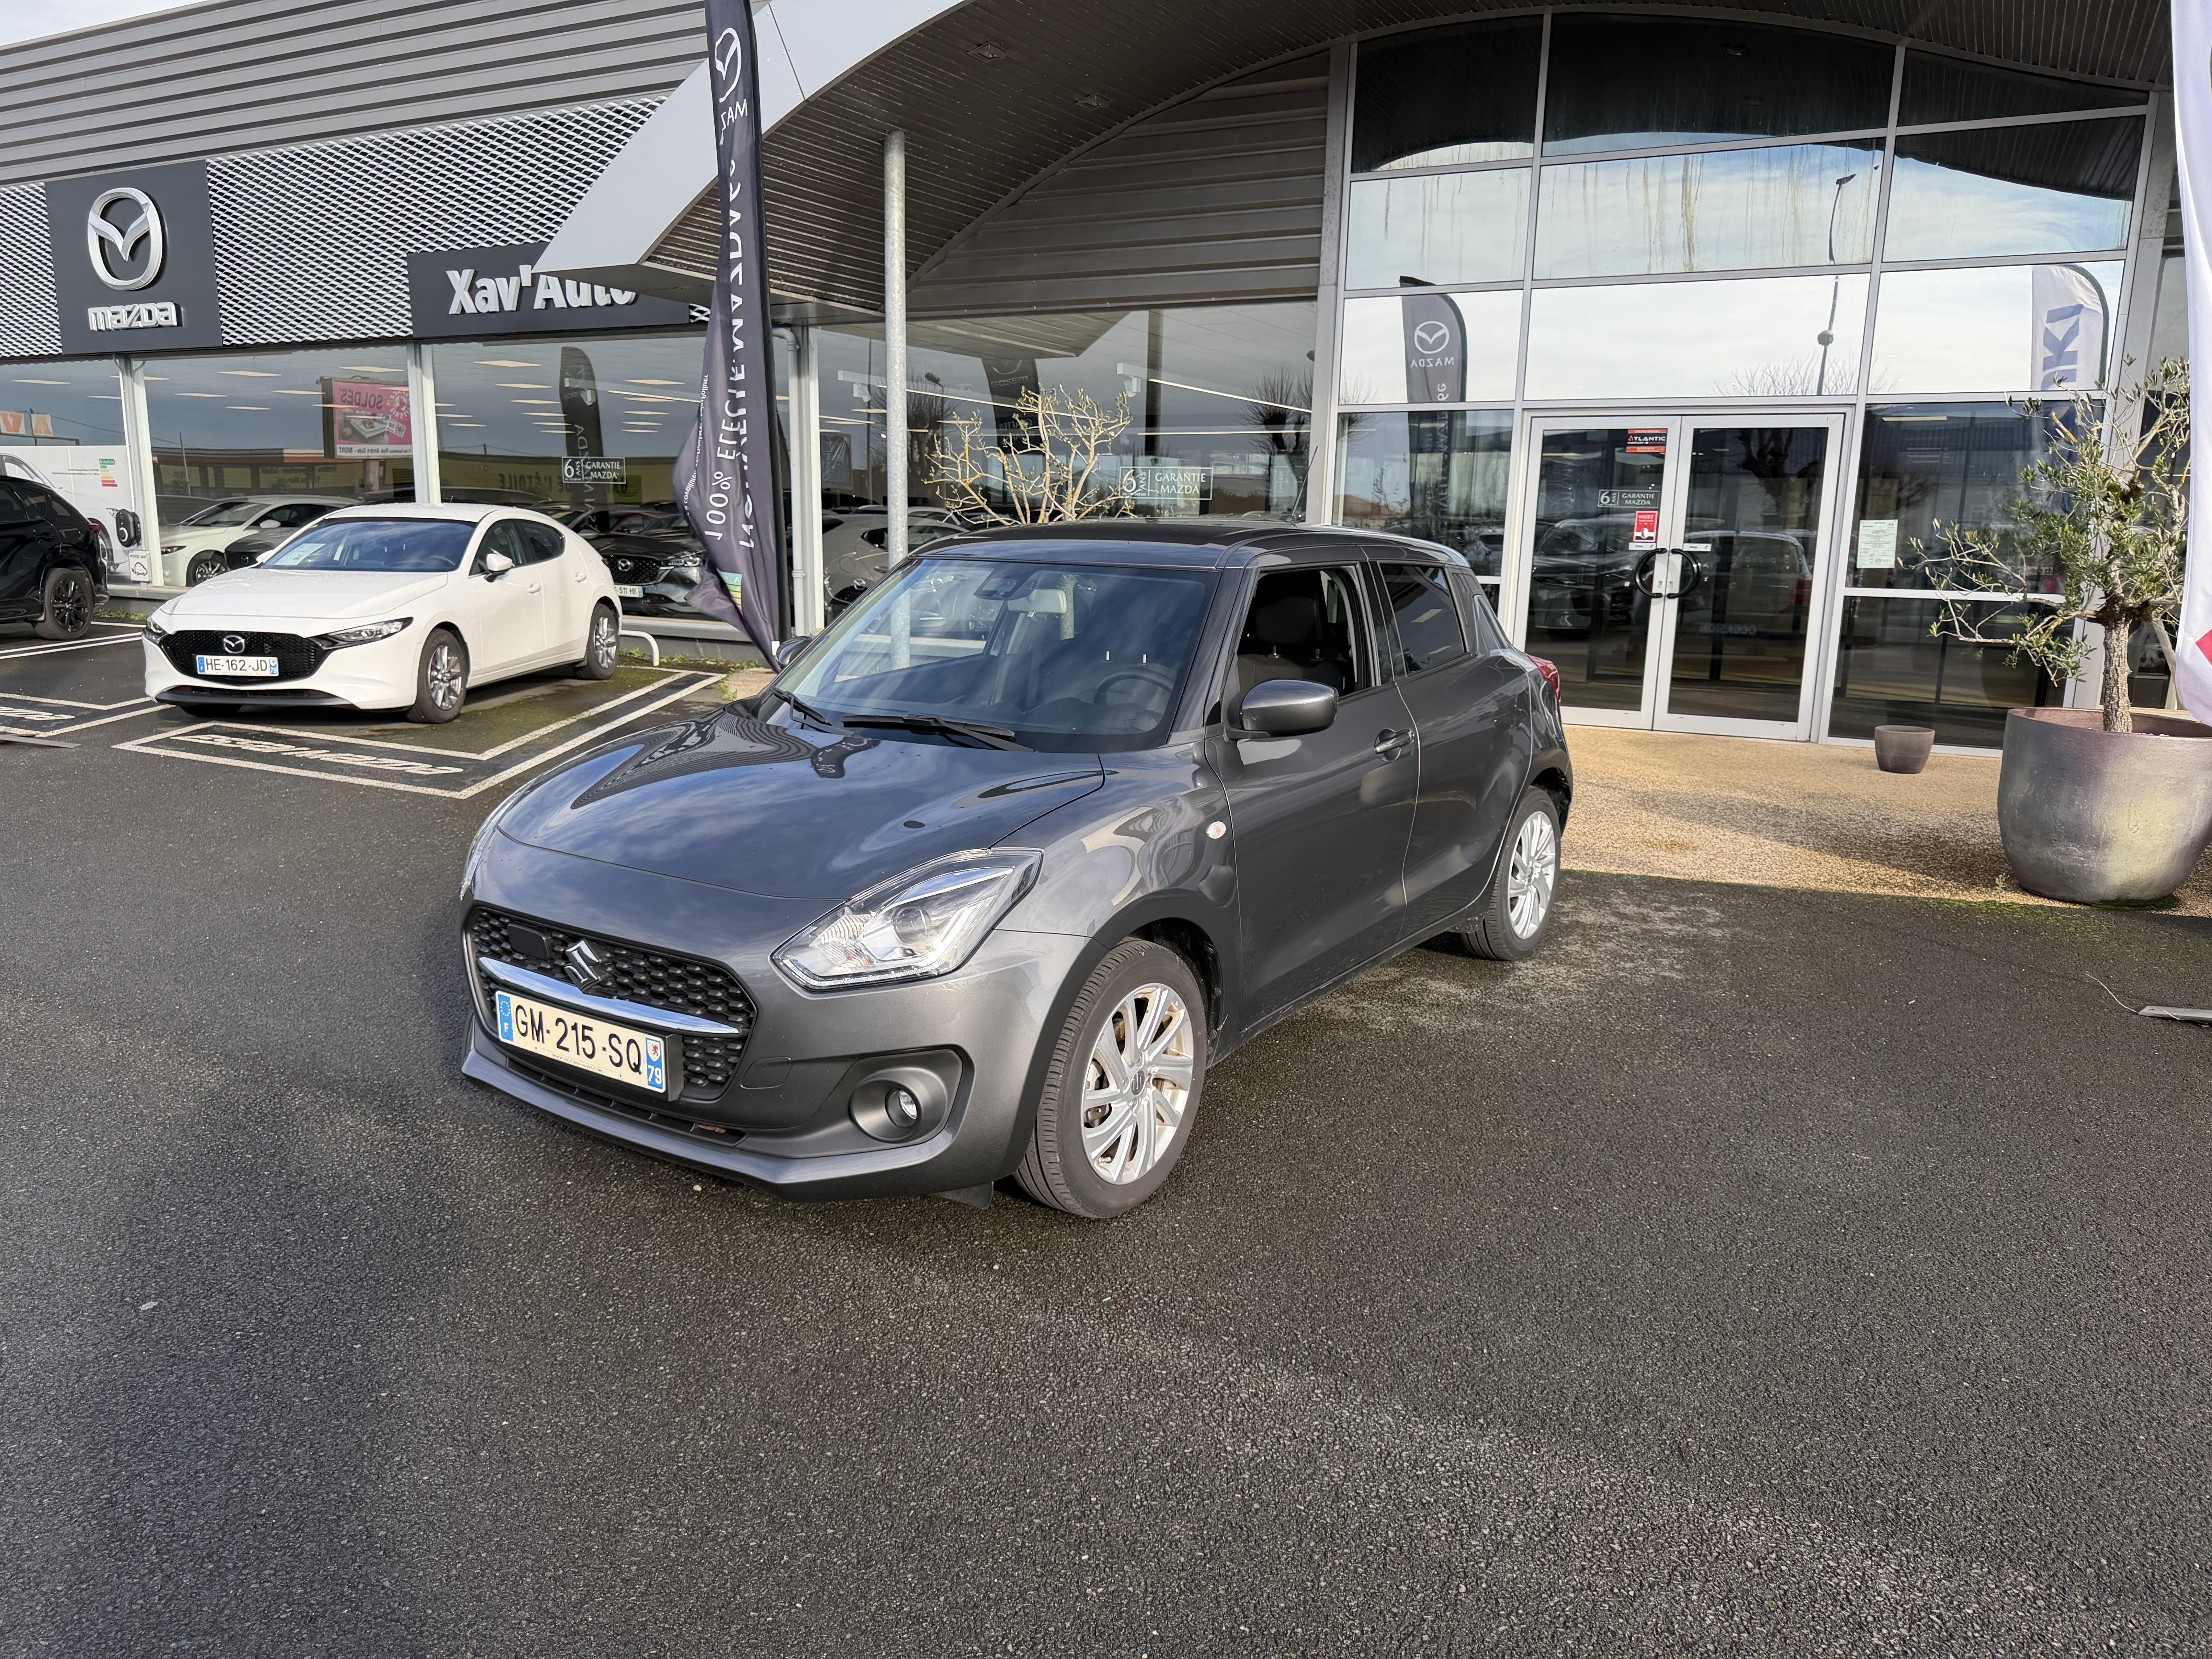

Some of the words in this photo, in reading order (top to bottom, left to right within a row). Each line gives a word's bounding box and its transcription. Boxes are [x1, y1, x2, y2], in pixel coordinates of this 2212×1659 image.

[564, 459, 574, 478] 6
[586, 461, 620, 469] GARANTIE
[591, 471, 618, 479] MAZDA
[1123, 469, 1137, 493] 6
[1155, 472, 1206, 482] GARANTIE
[1160, 485, 1200, 494] MAZDA
[1600, 491, 1610, 504] 6
[205, 658, 268, 672] HE-162-JD
[503, 1022, 508, 1033] F
[514, 1004, 643, 1075] GM-215-SQ
[647, 1064, 662, 1085] 79
